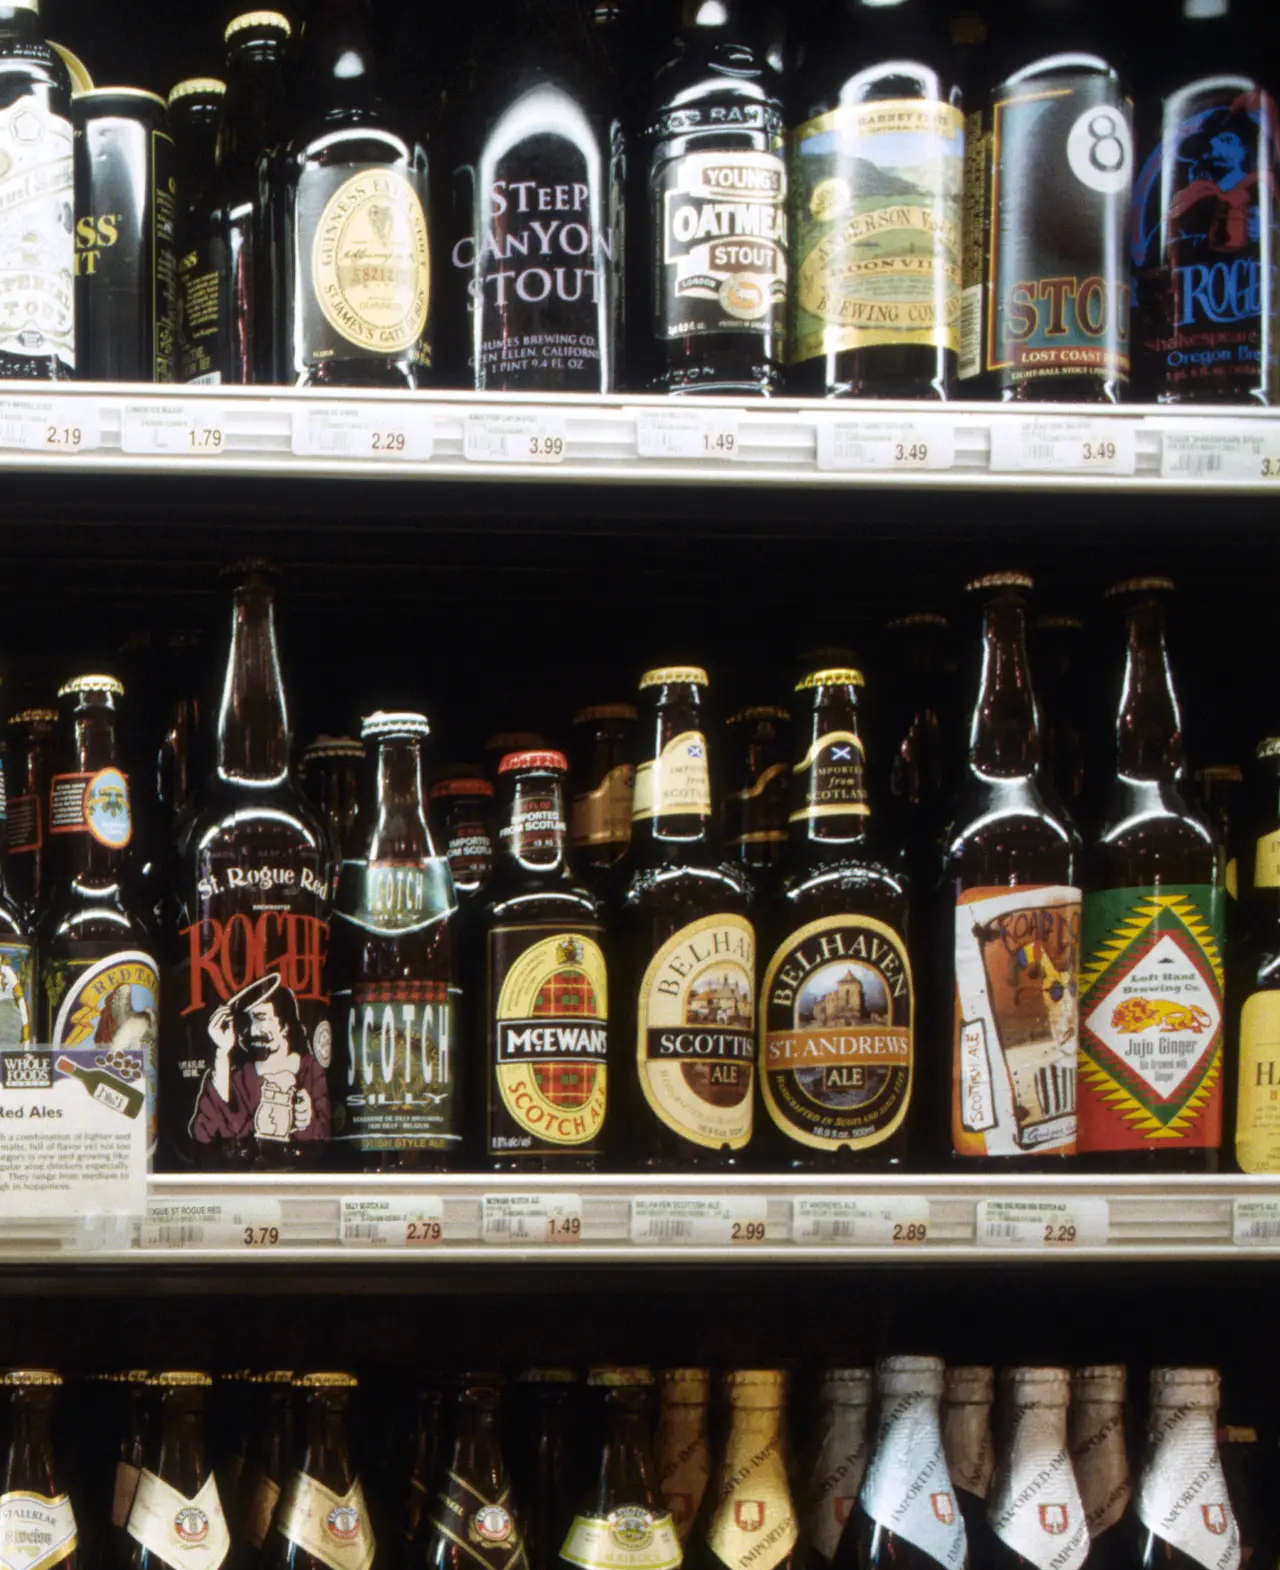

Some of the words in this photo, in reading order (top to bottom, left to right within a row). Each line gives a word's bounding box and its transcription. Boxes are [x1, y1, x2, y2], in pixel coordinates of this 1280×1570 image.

[707, 166, 779, 190] YOUNG'S
[488, 180, 590, 215] STEEP
[453, 222, 615, 268] CANYON
[712, 244, 777, 269] STOUT
[467, 269, 605, 313] STOUT
[189, 429, 222, 447] 1.79
[529, 437, 563, 455] 3.99
[1083, 442, 1115, 460] 3.49
[198, 877, 225, 900] St.
[228, 866, 295, 892] Rogue
[301, 871, 328, 899] Red
[179, 913, 331, 1016] ROGUE
[772, 933, 909, 1009] BELHAVEN
[349, 1003, 450, 1087] SCOTCH
[769, 1038, 800, 1058] ST.
[804, 1037, 909, 1057] ANDREWS
[1125, 1037, 1155, 1059] Juju
[1158, 1037, 1199, 1061] Ginger
[4, 1057, 50, 1072] WHOLE
[7, 1069, 49, 1081] FOODS
[826, 1068, 863, 1088] ALE
[347, 1093, 450, 1108] SILLY
[29, 1106, 63, 1119] Ales
[406, 1222, 441, 1241] 2.79
[732, 1222, 766, 1242] 2.99
[1043, 1225, 1077, 1243] 2.29
